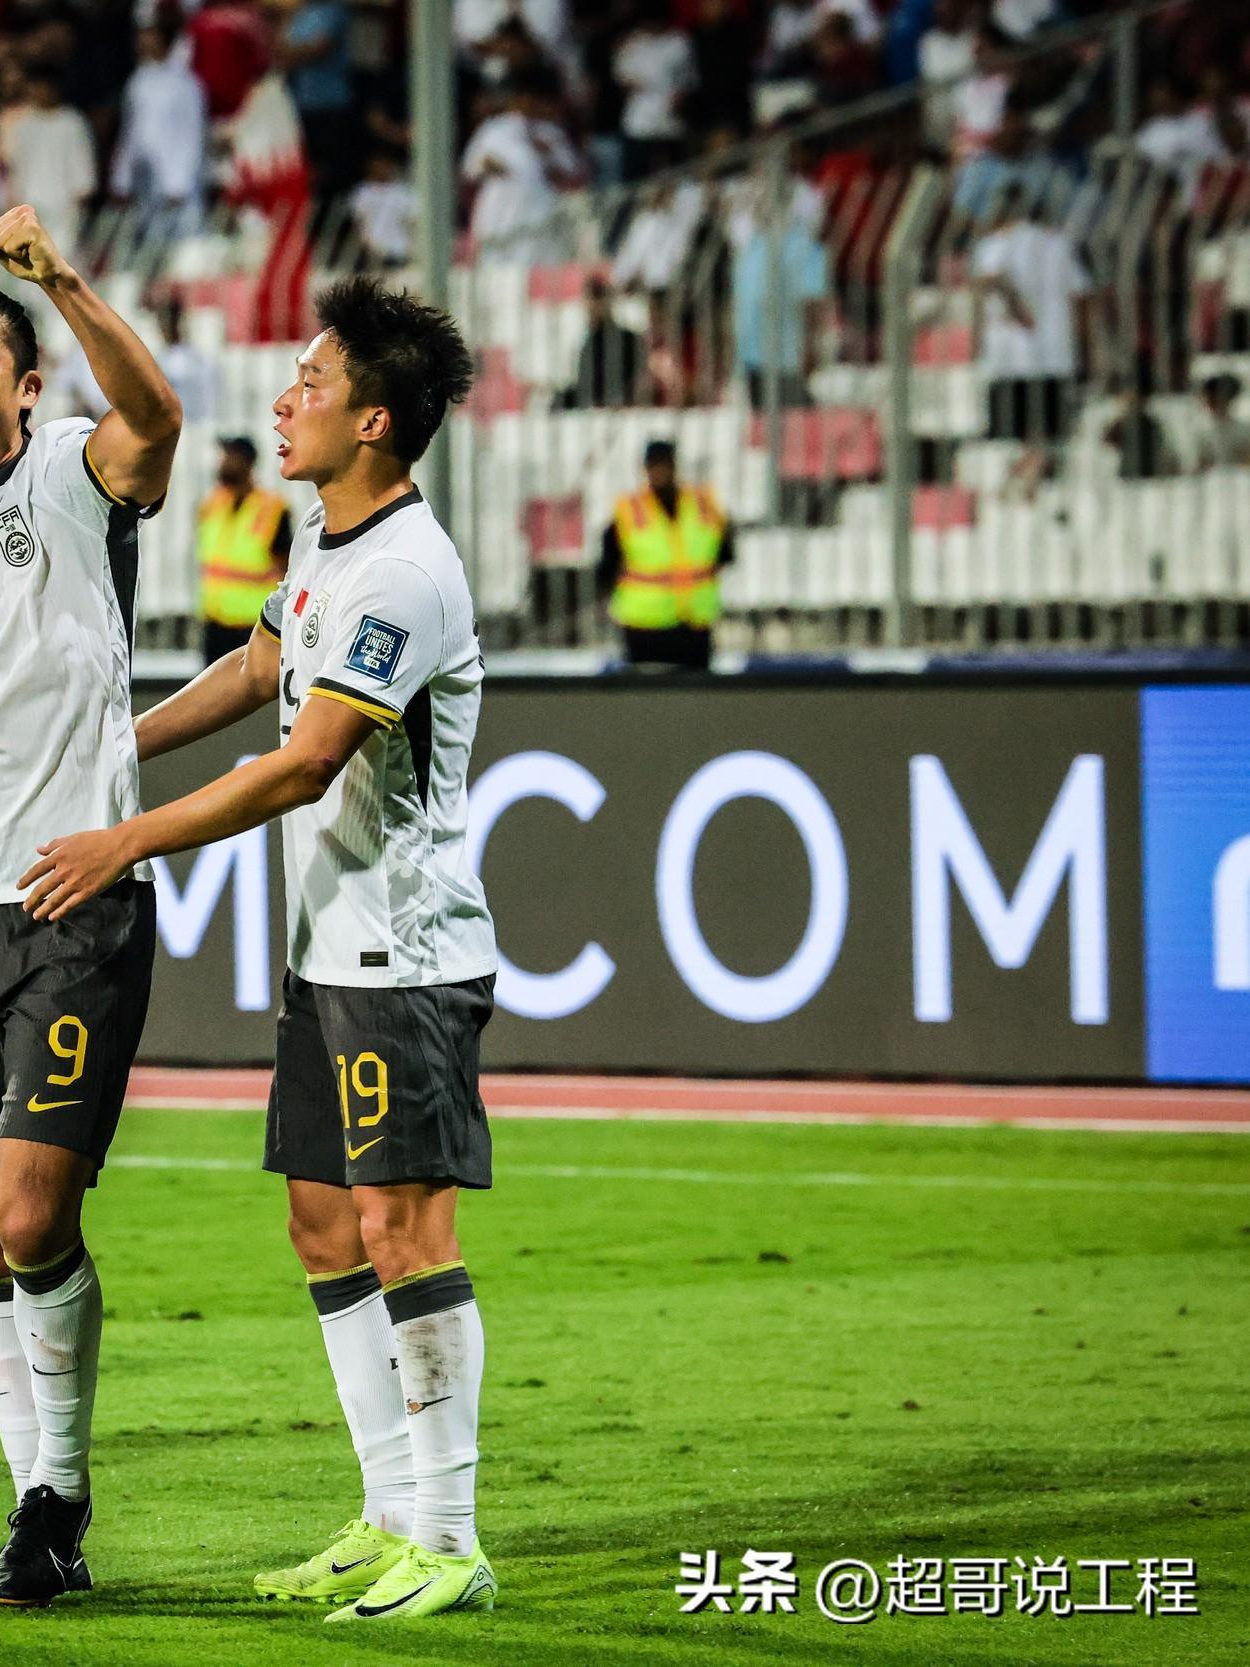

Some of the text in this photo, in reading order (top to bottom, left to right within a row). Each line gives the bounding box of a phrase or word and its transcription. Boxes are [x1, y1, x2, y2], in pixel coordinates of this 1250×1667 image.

[365, 635, 394, 654] UNITES
[368, 627, 396, 645] FOOTBALL
[47, 1015, 88, 1086] 9
[336, 1051, 389, 1128] 19
